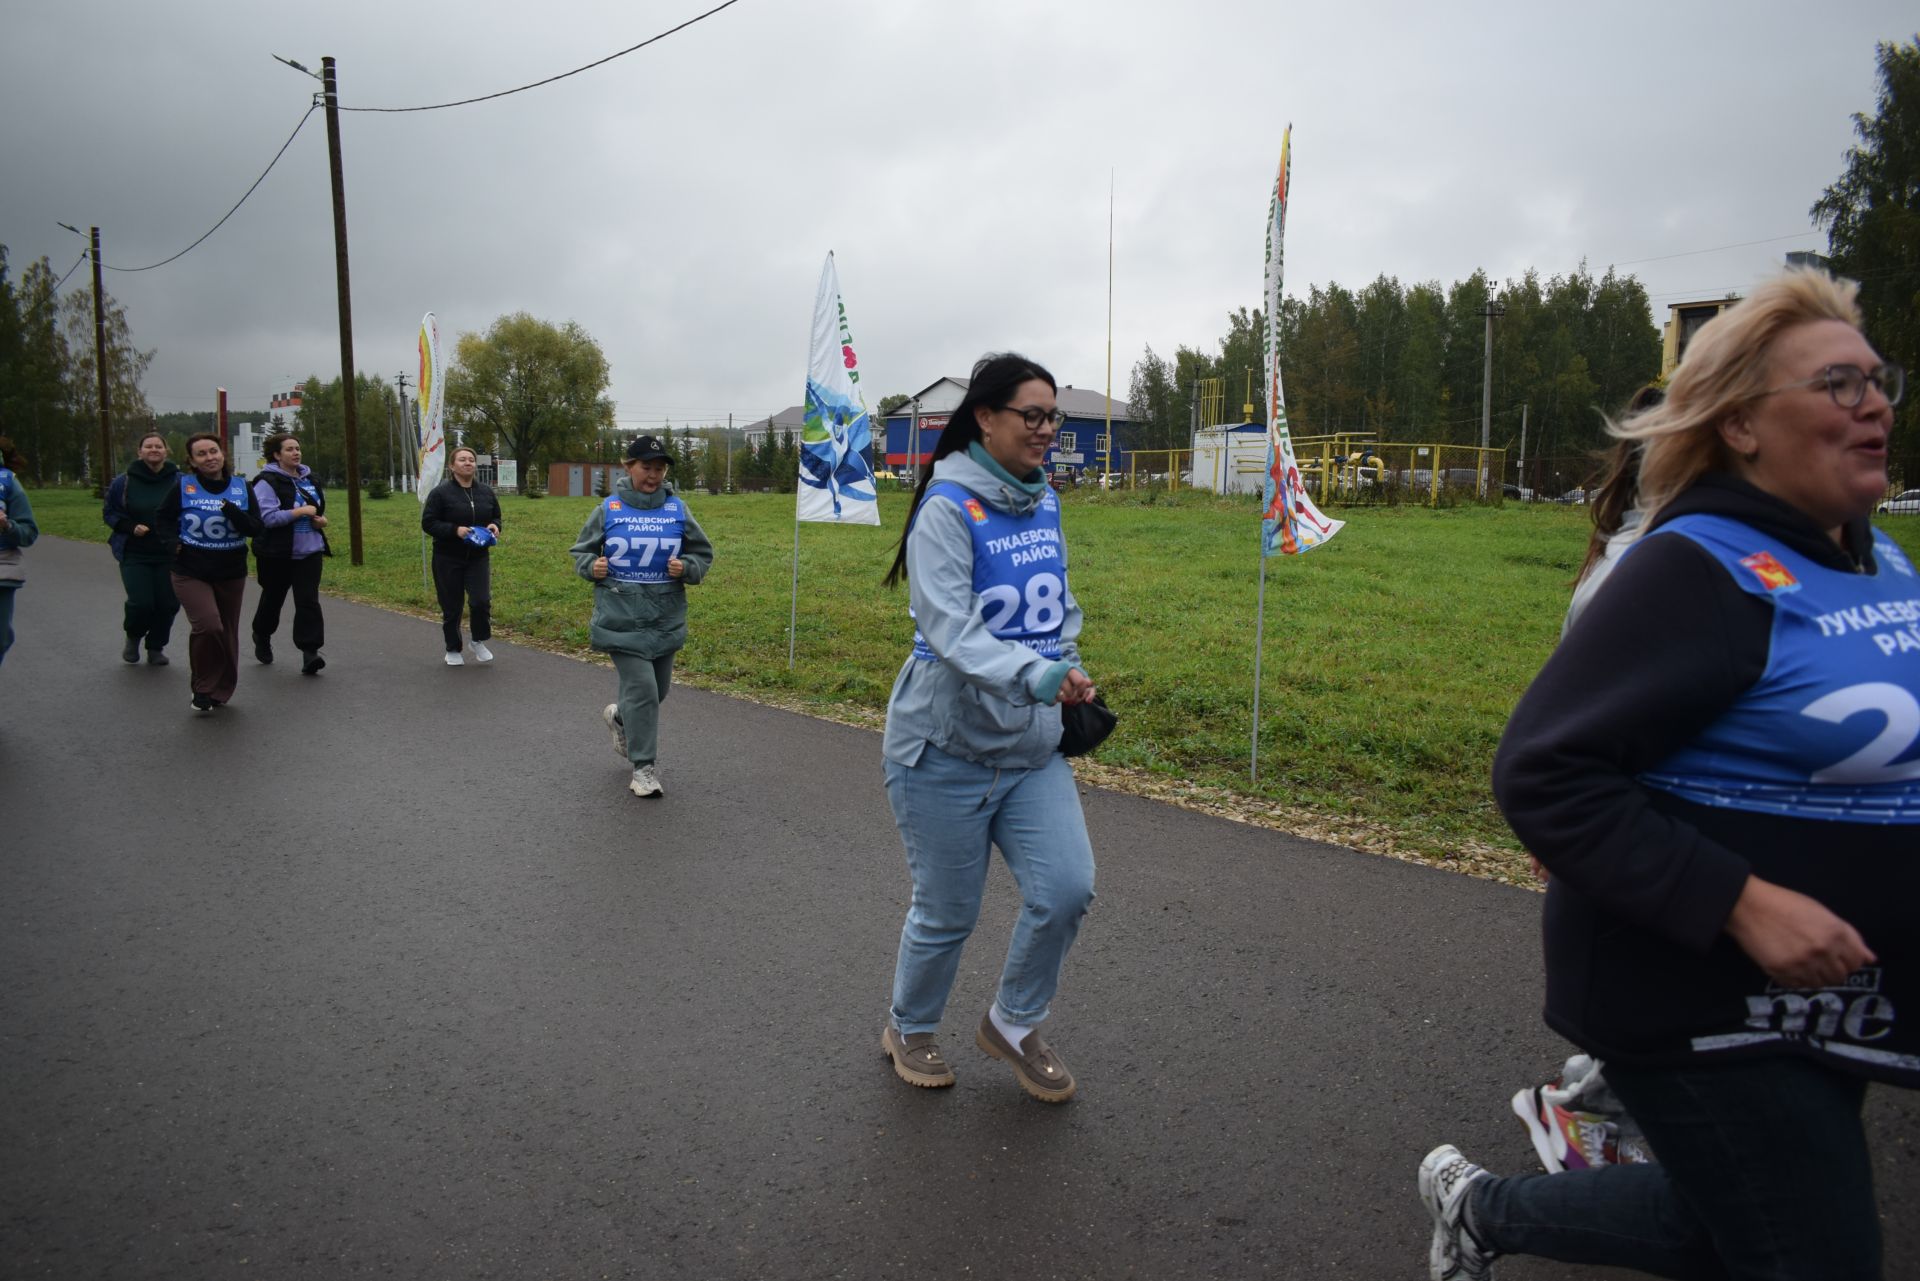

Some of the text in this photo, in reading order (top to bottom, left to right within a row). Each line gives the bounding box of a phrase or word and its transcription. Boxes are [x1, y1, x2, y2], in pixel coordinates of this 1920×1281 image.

[613, 516, 677, 525] ТУКАЕВСКИЙ
[627, 523, 664, 533] РАЙОН
[605, 536, 682, 567] 277
[985, 527, 1060, 555] ТУКАЕВСКИЙ
[1011, 544, 1059, 568] РАЙОН
[980, 572, 1065, 633] 28
[1800, 681, 1920, 785] 2
[1744, 991, 1896, 1041] me
